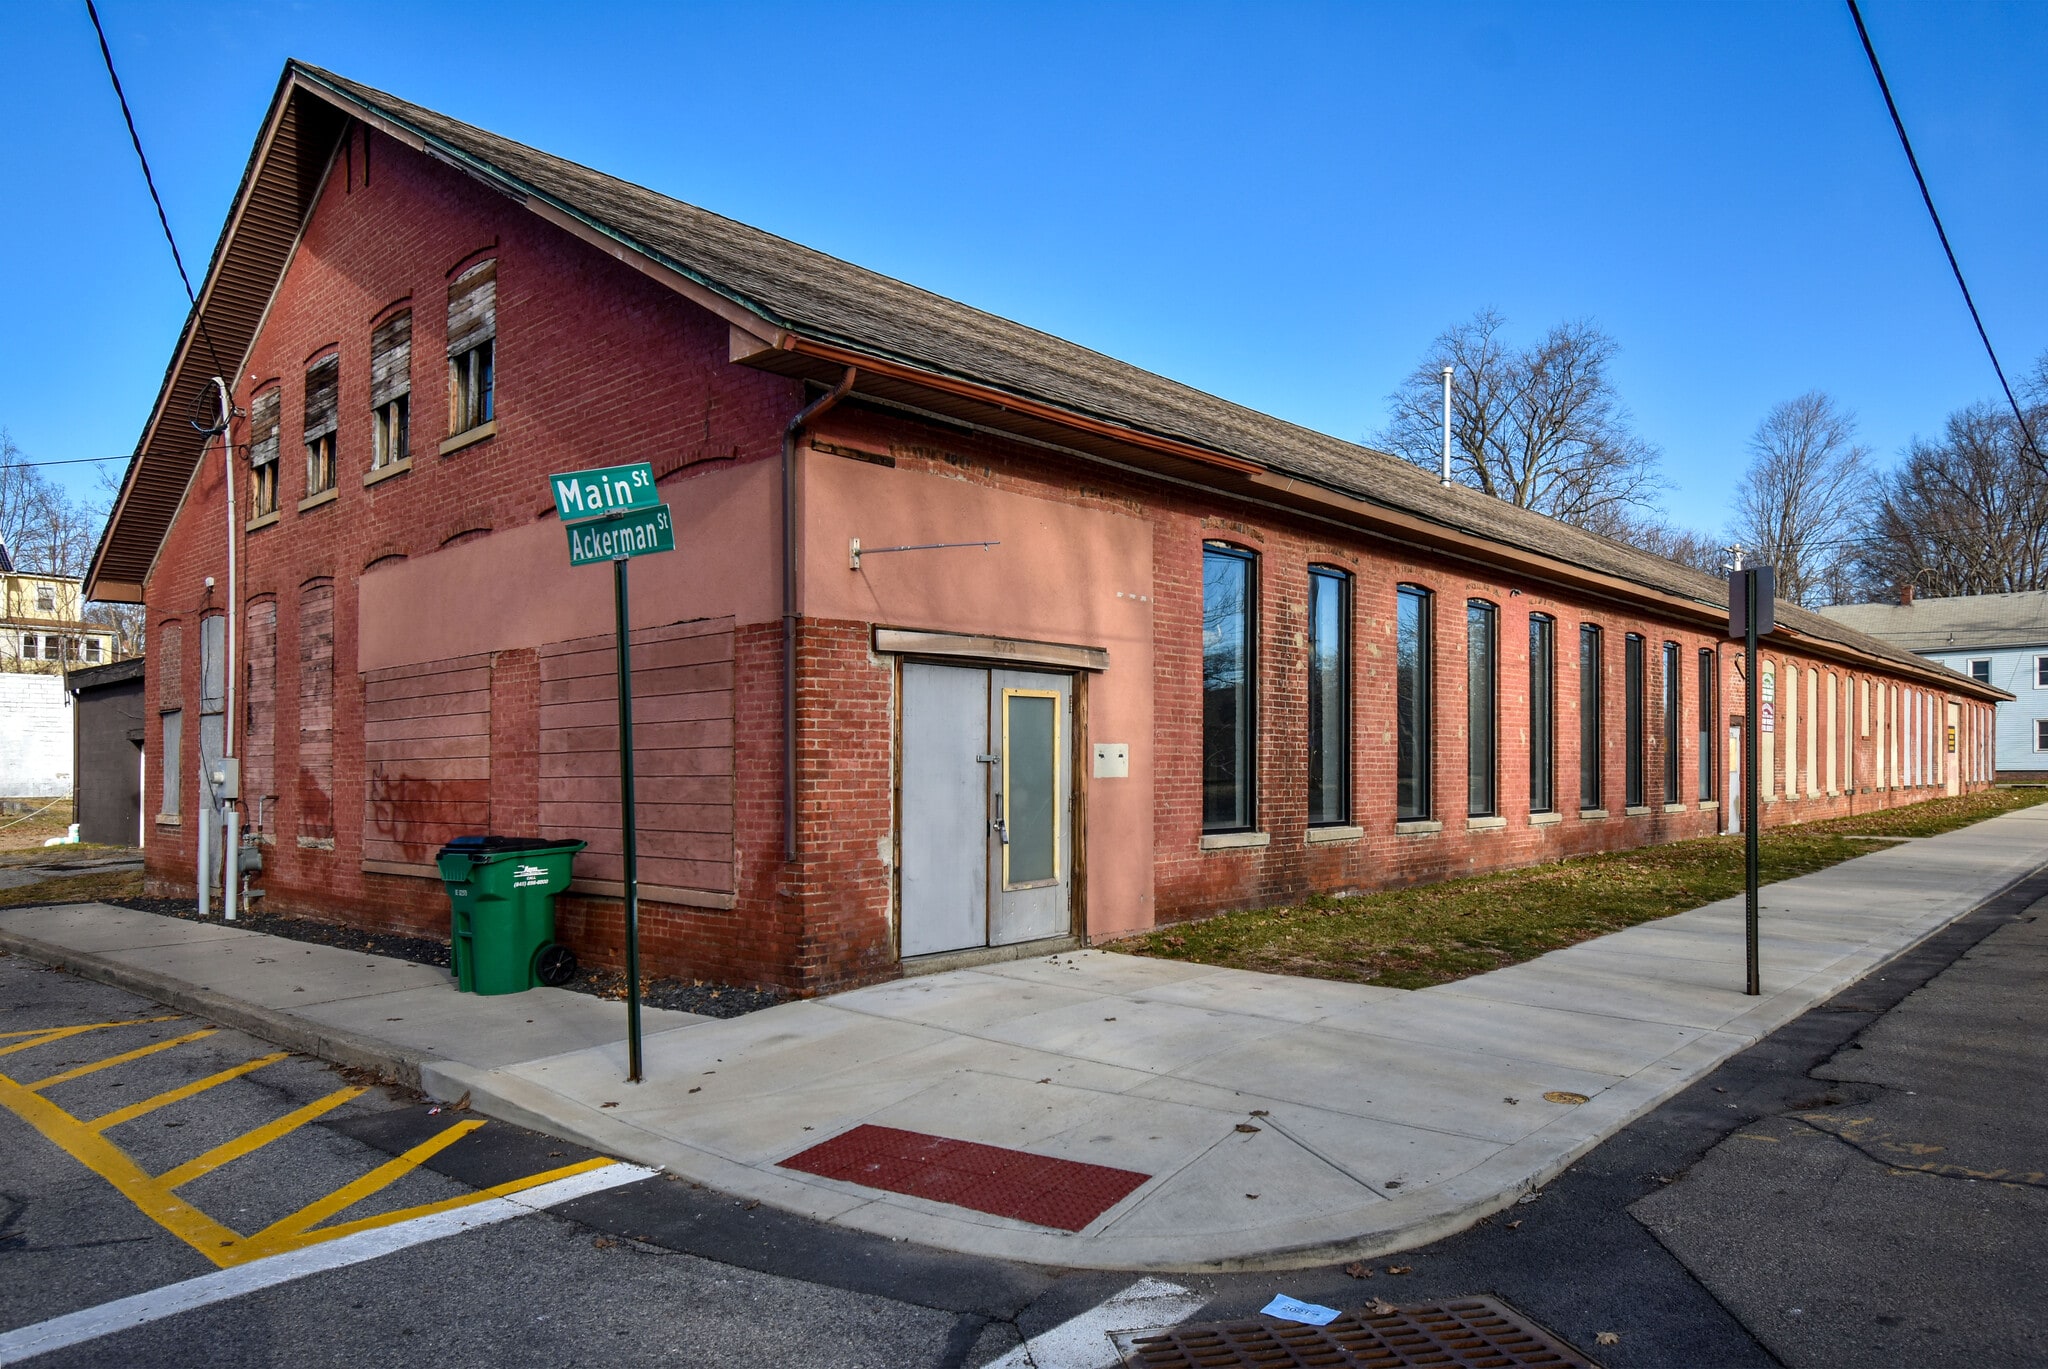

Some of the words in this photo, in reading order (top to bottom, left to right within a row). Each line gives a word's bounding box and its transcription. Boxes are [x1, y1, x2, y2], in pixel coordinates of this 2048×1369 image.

[557, 475, 633, 513] Main
[632, 469, 650, 487] St
[573, 523, 658, 561] Ackerman
[657, 513, 669, 530] St
